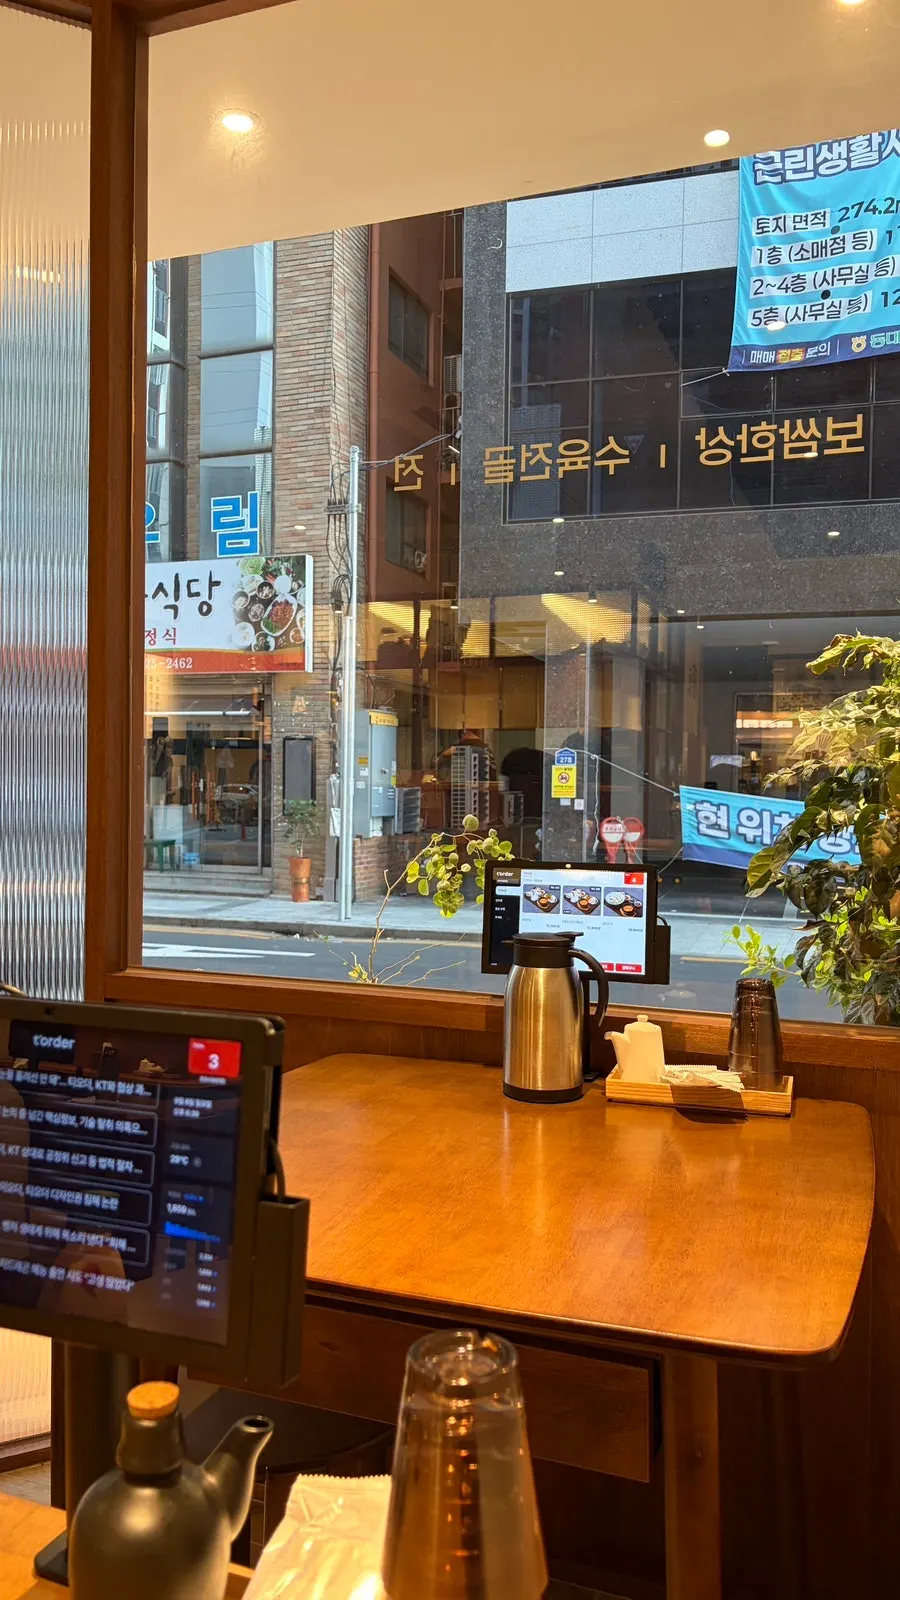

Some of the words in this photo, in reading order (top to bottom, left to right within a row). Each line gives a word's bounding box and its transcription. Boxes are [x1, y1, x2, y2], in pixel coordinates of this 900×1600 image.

[756, 216, 787, 235] 토지
[792, 211, 827, 231] 면적
[756, 246, 782, 265] 1층
[788, 235, 846, 263] (소매점
[851, 230, 874, 251] 등)
[752, 274, 808, 296] 2~4층
[813, 263, 870, 290] (사무실
[874, 256, 896, 277] 등)
[751, 307, 779, 327] 5층
[785, 299, 842, 323] (사무실
[847, 293, 868, 314] 등)
[750, 350, 776, 363] 매매
[211, 491, 260, 558] 림
[145, 569, 222, 621] 식당
[695, 801, 730, 839] 현
[208, 1053, 220, 1070] 3
